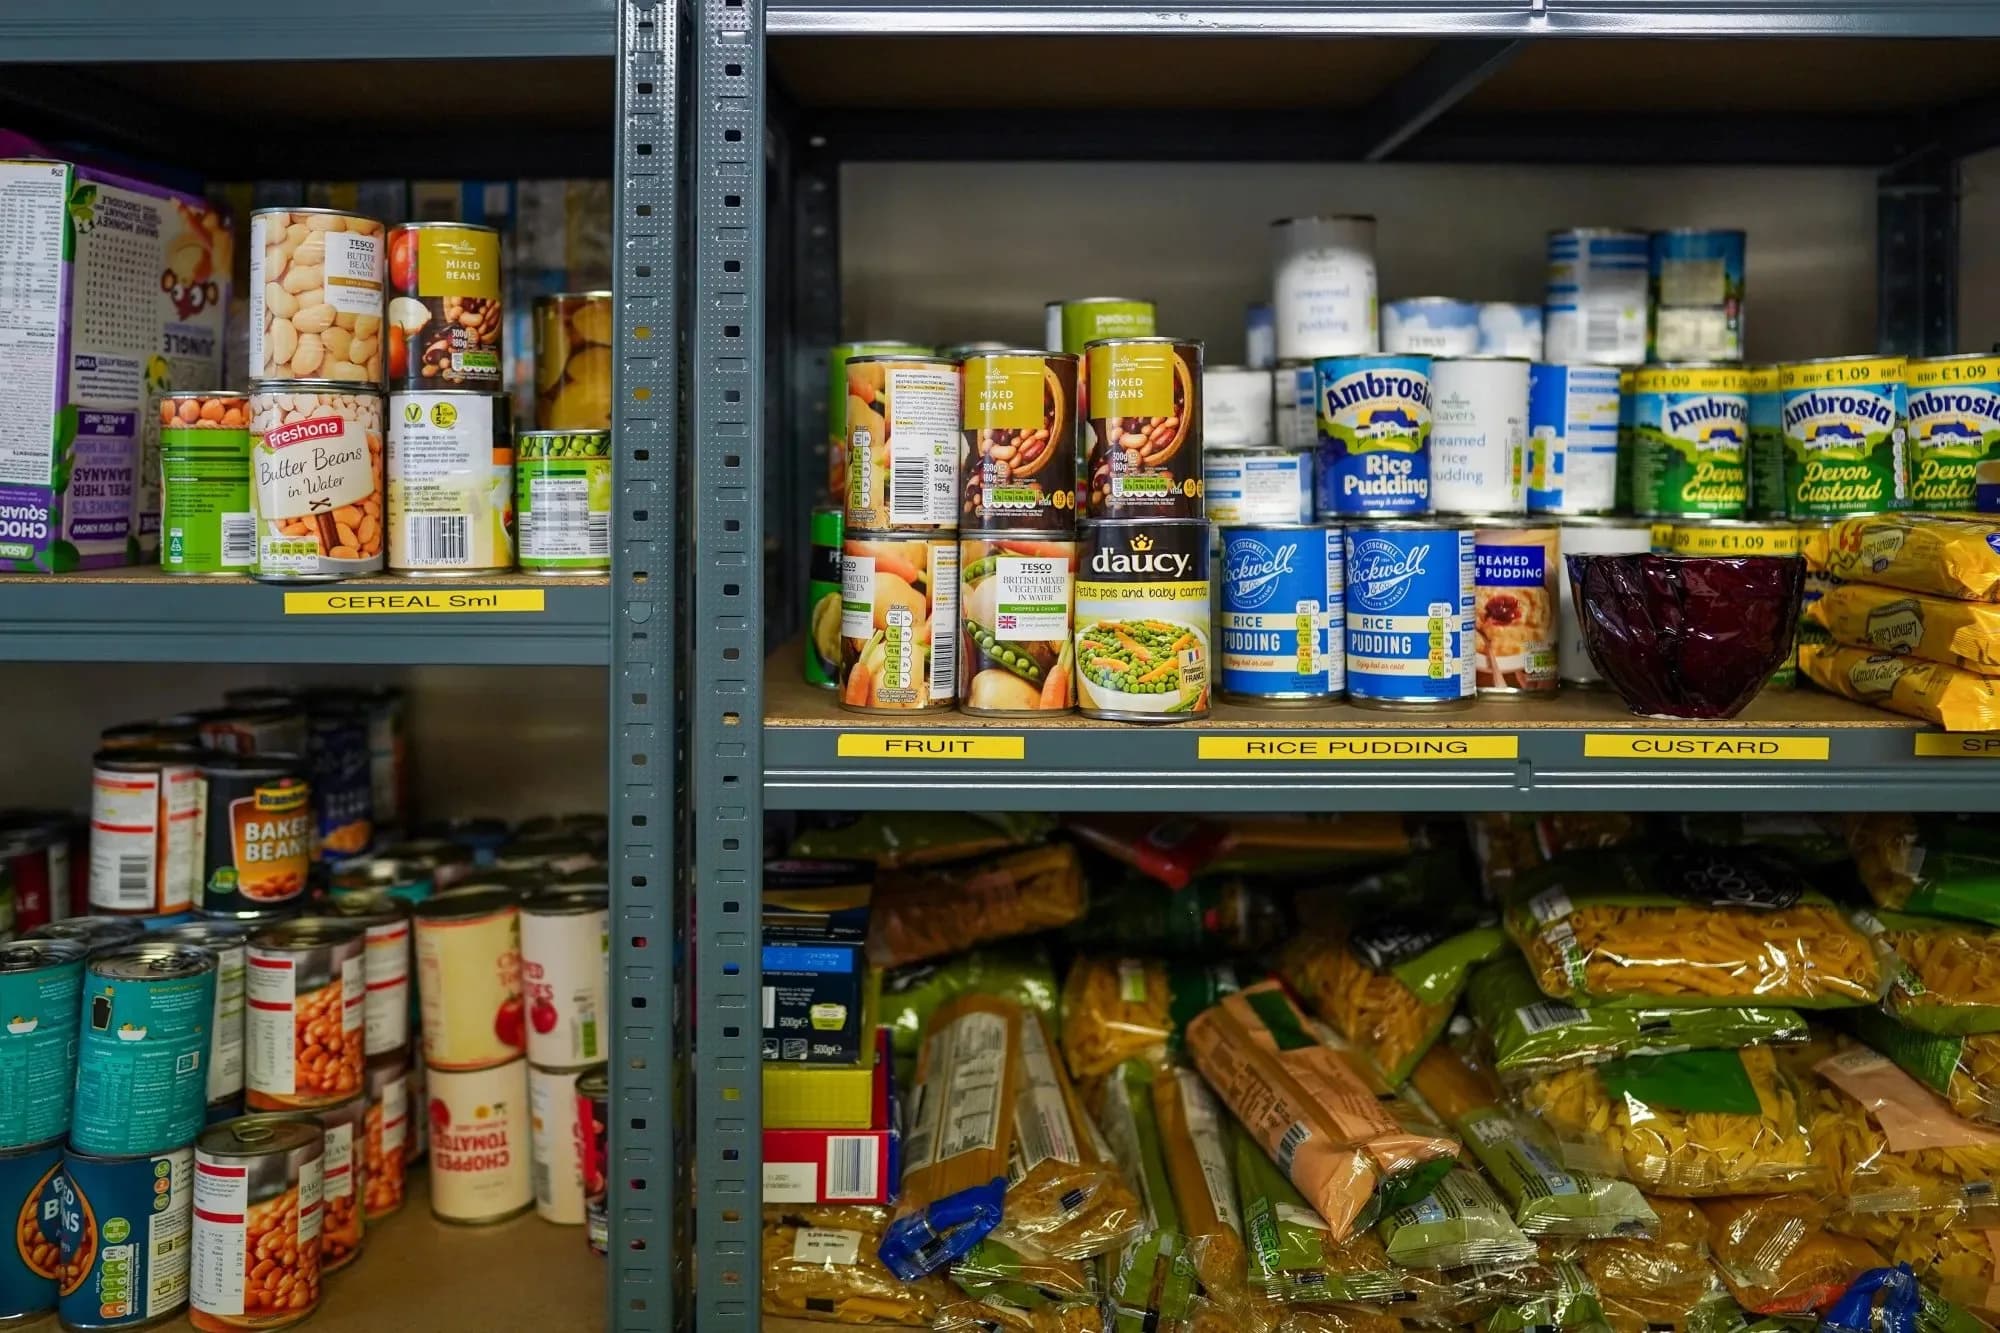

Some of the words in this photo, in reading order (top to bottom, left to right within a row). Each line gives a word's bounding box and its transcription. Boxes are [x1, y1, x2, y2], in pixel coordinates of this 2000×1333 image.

[349, 239, 374, 249] TESCO
[446, 260, 480, 270] MIXED
[446, 271, 480, 280] BEANS
[163, 334, 213, 356] JUNGLE
[1803, 374, 1821, 382] RRP
[1826, 368, 1870, 381] £1.09
[1918, 372, 1937, 382] RRP
[1942, 365, 1986, 380] £1.09
[1108, 378, 1143, 387] MIXED
[1652, 376, 1690, 386] £1.09
[981, 390, 1013, 399] MIXED
[1108, 390, 1144, 399] BEANS
[980, 402, 1014, 410] BEANS
[1783, 392, 1891, 432] Ambrosia
[1668, 399, 1748, 432] Ambros
[268, 422, 338, 448] Freshona
[1434, 434, 1486, 447] reamed
[1112, 452, 1128, 462] 300g
[1442, 454, 1468, 463] rice
[261, 459, 308, 485] Butter
[312, 447, 362, 470] Beans
[934, 464, 952, 475] 300g
[1366, 454, 1412, 475] Rice
[1804, 460, 1871, 481] Devon
[1920, 460, 1976, 480] Devo
[75, 468, 131, 481] BANANAS
[1435, 469, 1483, 484] udding
[73, 484, 105, 496] THEIR
[109, 483, 131, 496] PEEL
[288, 486, 300, 497] in
[304, 476, 345, 494] Water
[934, 483, 950, 494] 195g
[1344, 474, 1428, 498] Pudding
[1798, 478, 1882, 501] Custard
[0, 504, 48, 521] SQUAR
[1721, 537, 1764, 548] £1.09
[1366, 541, 1398, 558] STOCKWELL
[1092, 547, 1190, 578] d'aucy
[1476, 556, 1529, 565] REAMED
[1486, 568, 1542, 578] PUDDING
[1003, 576, 1038, 584] BRITISH
[1040, 576, 1064, 584] MIXED
[1076, 586, 1097, 598] Petits
[1101, 588, 1118, 600] pois
[1122, 588, 1143, 598] and
[1149, 587, 1176, 600] baby
[328, 596, 440, 608] CEREAL
[1234, 616, 1262, 628] RICE
[1363, 618, 1393, 630] RICE
[1891, 622, 1916, 641] Lemon
[1224, 632, 1280, 652] PUDDING
[1352, 634, 1411, 654] PUDDING
[1186, 672, 1204, 683] FRANCE
[885, 740, 975, 753] FRUIT
[1247, 742, 1317, 754] RICE
[1329, 741, 1468, 754] PUDDING
[1632, 740, 1779, 754] CUSTARD
[246, 816, 307, 841] BAKE
[246, 840, 302, 862] BEAN
